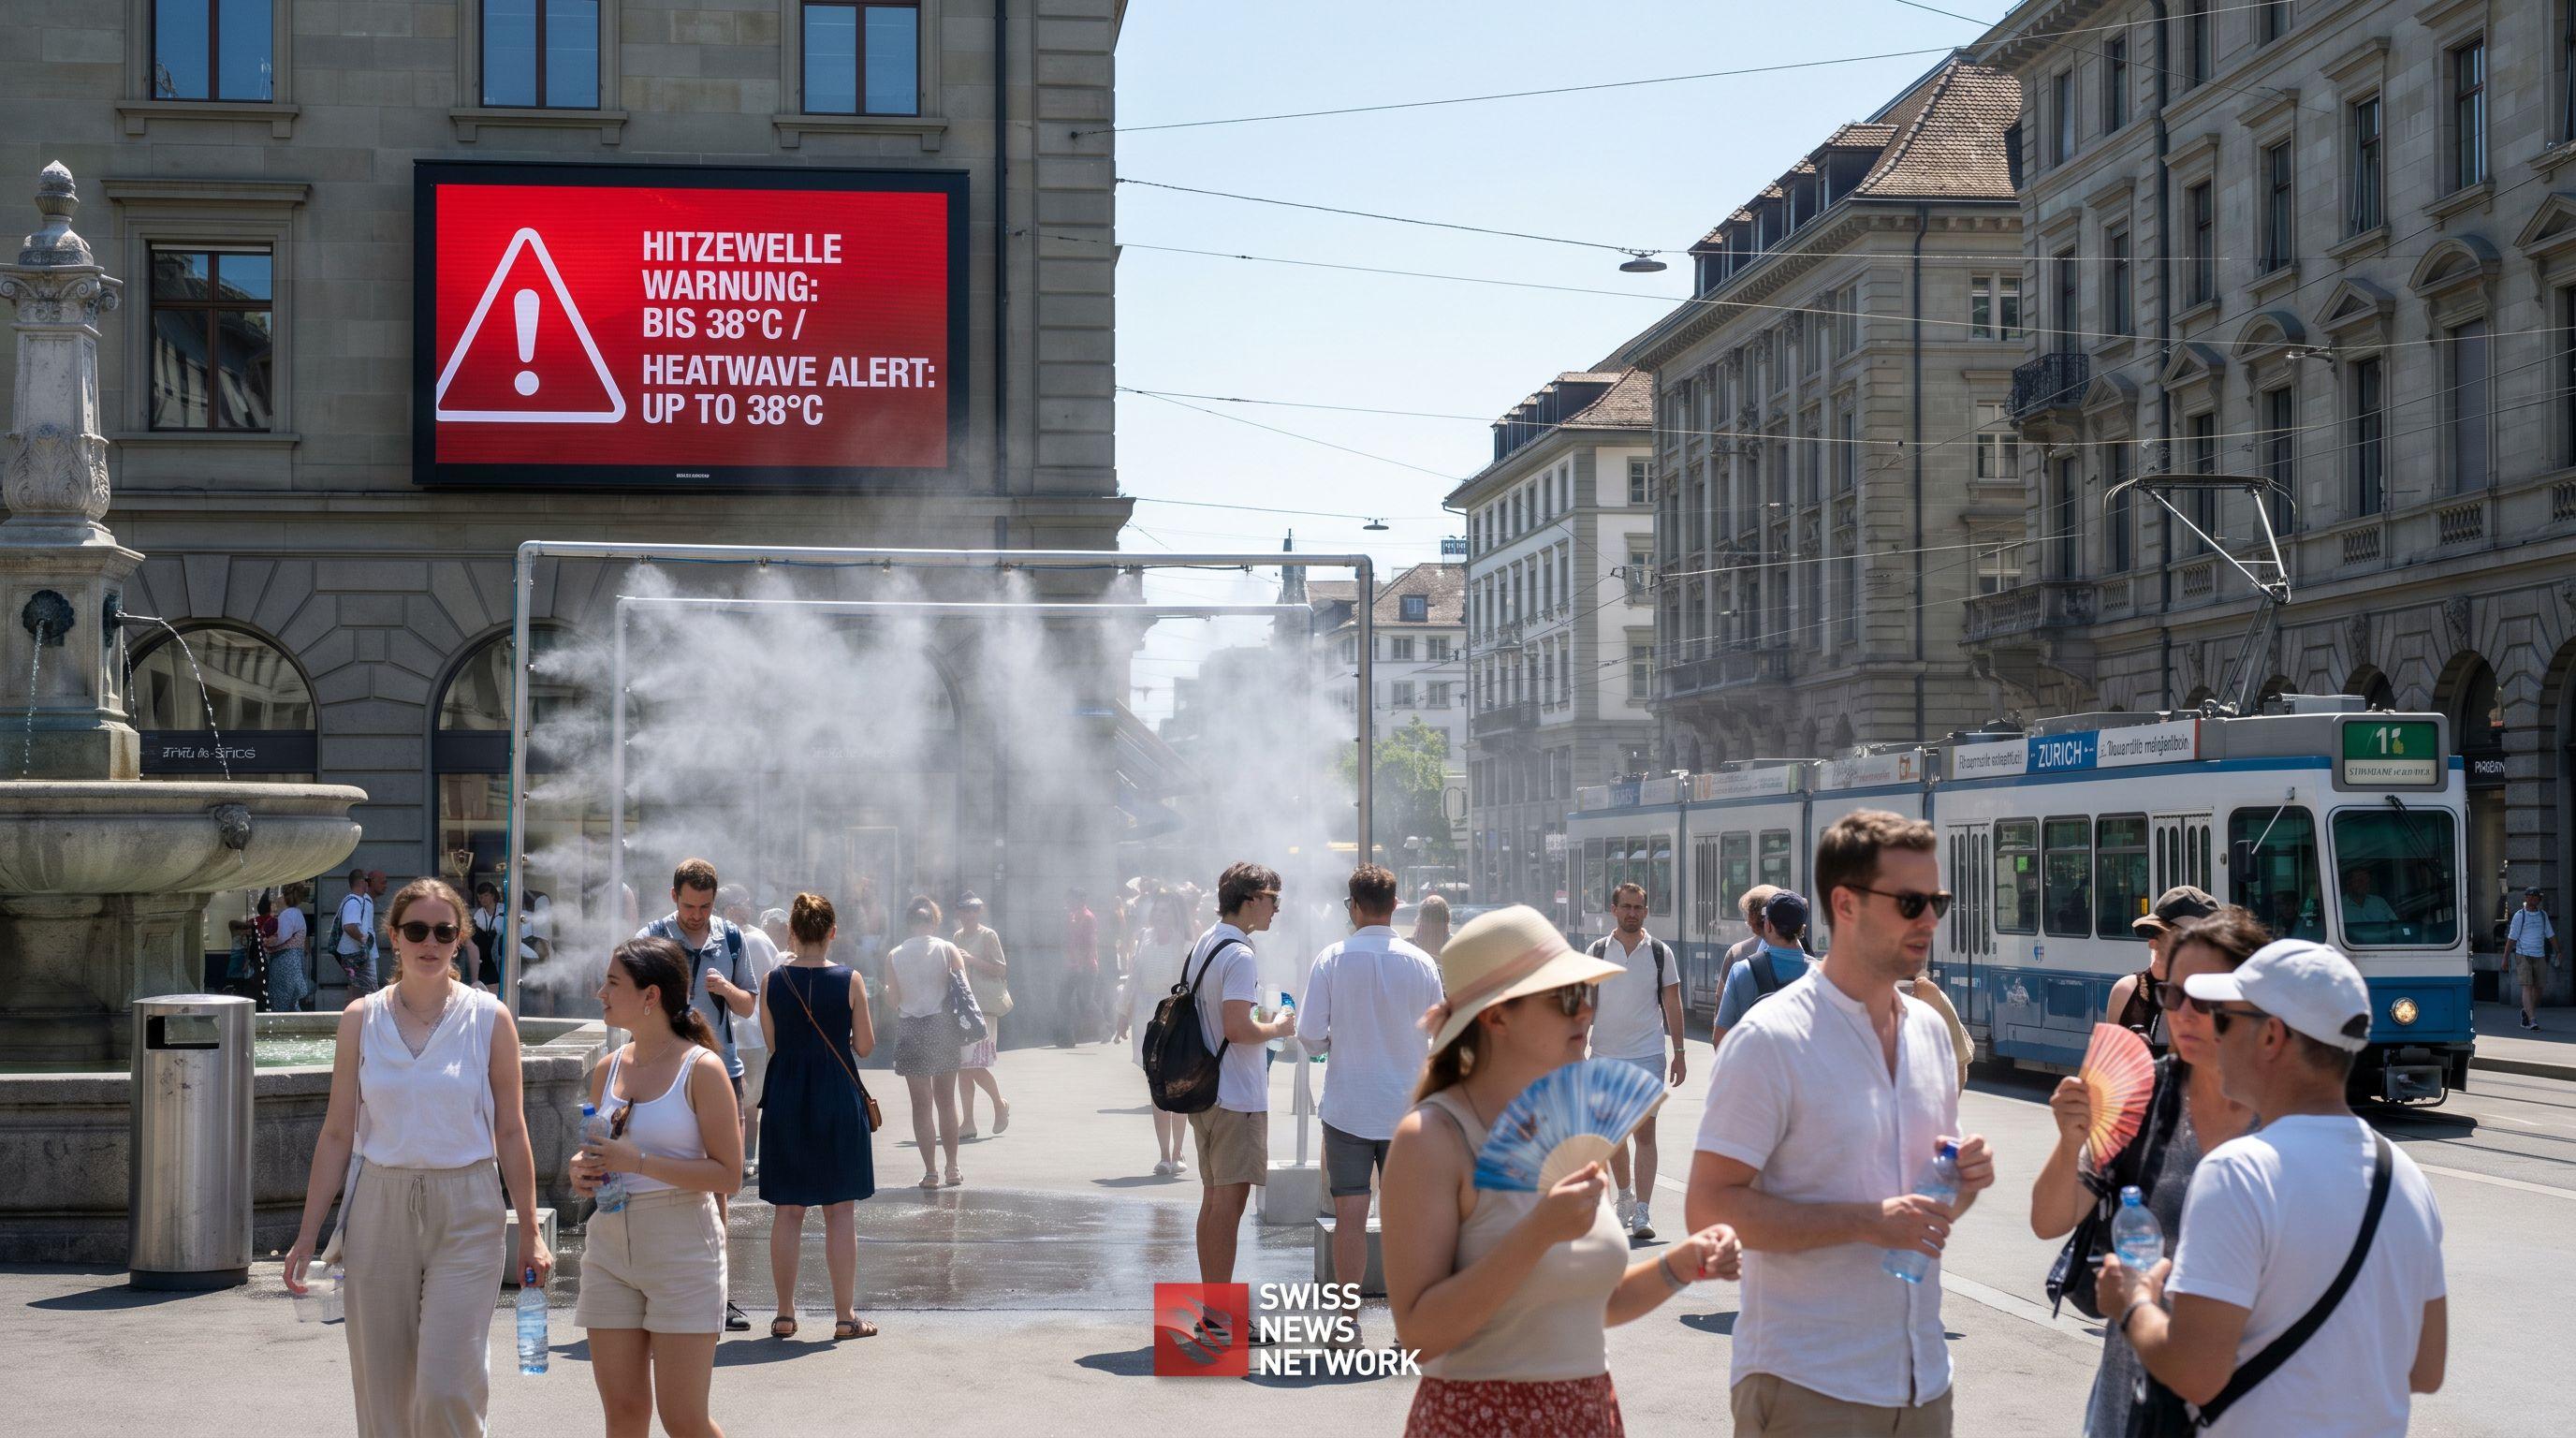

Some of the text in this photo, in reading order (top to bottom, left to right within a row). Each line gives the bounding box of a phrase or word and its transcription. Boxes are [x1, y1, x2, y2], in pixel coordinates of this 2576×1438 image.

[644, 231, 842, 263] HITZEWELLE
[643, 270, 817, 301] WARNUNG:
[644, 307, 806, 340] BIS 38°C /
[644, 355, 934, 388] HEATWAVE ALERT:
[643, 393, 823, 425] UP TO 38°C
